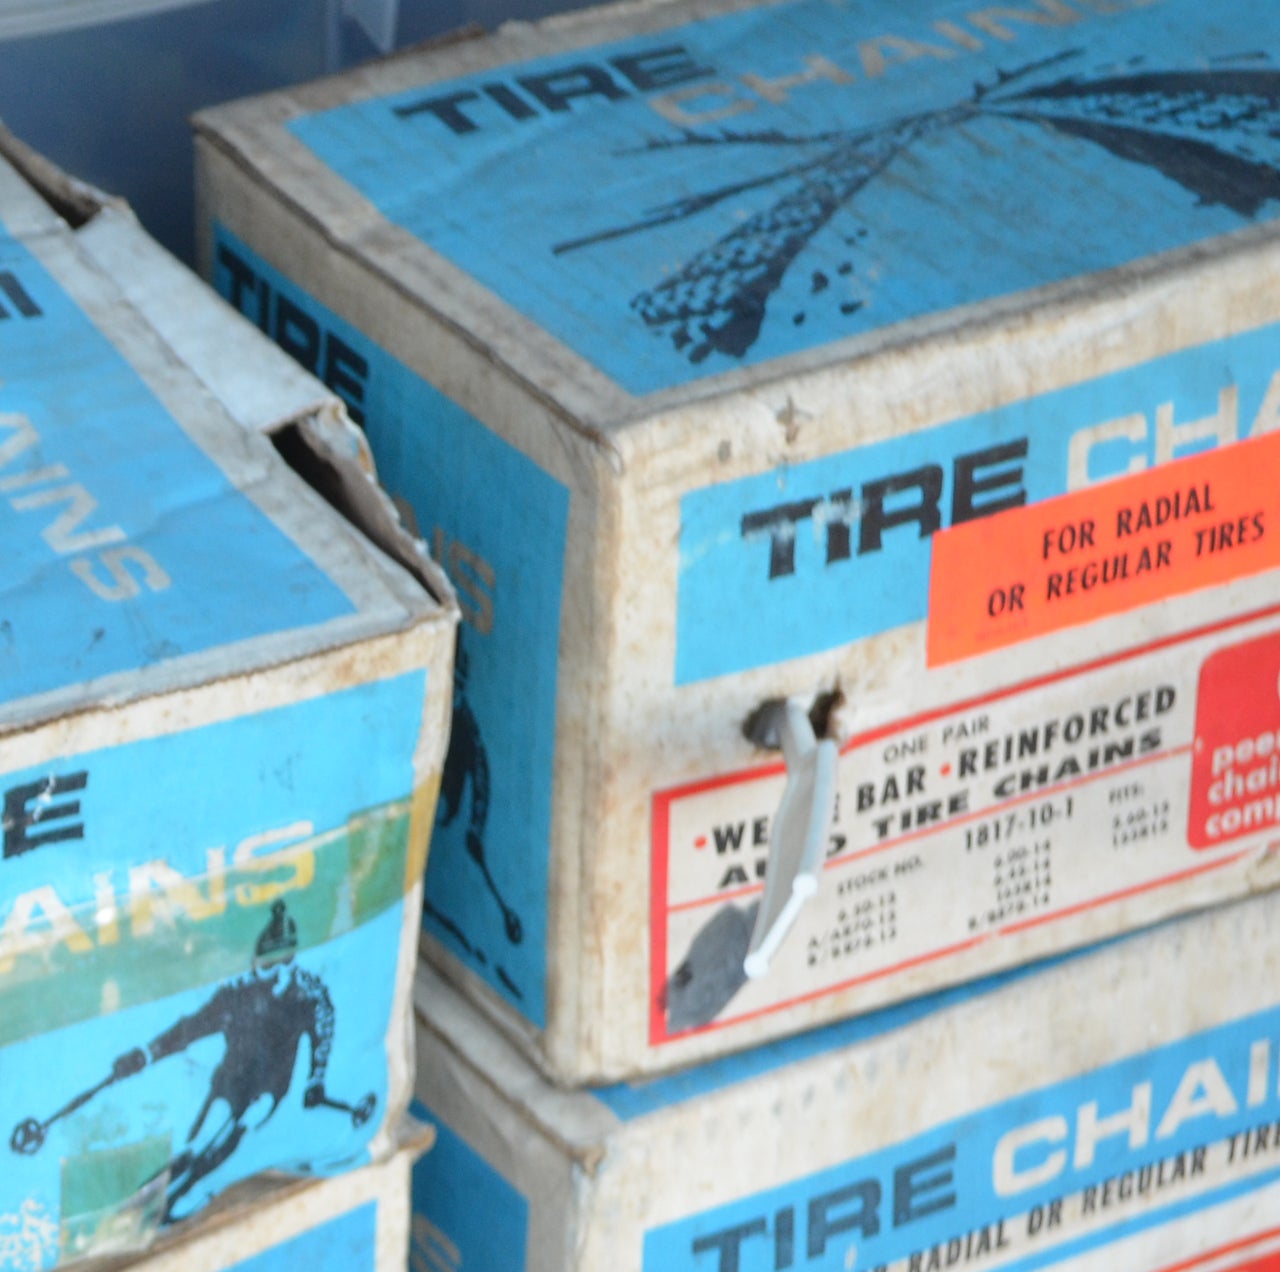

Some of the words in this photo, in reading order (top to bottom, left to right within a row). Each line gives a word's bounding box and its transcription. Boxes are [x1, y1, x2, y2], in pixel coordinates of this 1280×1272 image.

[390, 43, 720, 138] TIRE
[648, 0, 1132, 125] CHAIN
[740, 437, 1029, 581] TIRE
[987, 583, 1026, 618] OR
[1046, 540, 1172, 602] REGULAR
[1192, 511, 1265, 559] TIRES
[1042, 516, 1095, 560] FOR
[1115, 483, 1214, 539] RADIAL
[855, 763, 927, 815] BAR
[957, 684, 1176, 780] REINFORCED
[871, 790, 972, 842] TIRE
[992, 726, 1164, 801] CHAINS
[883, 735, 928, 764] ONE
[942, 714, 991, 744] PAIR
[963, 797, 1074, 853] 1817-10-1
[991, 1037, 1280, 1199] CHAI
[1027, 1199, 1065, 1237] OR
[1081, 1145, 1207, 1217] REGULAR
[1227, 1117, 1280, 1165] TIRE
